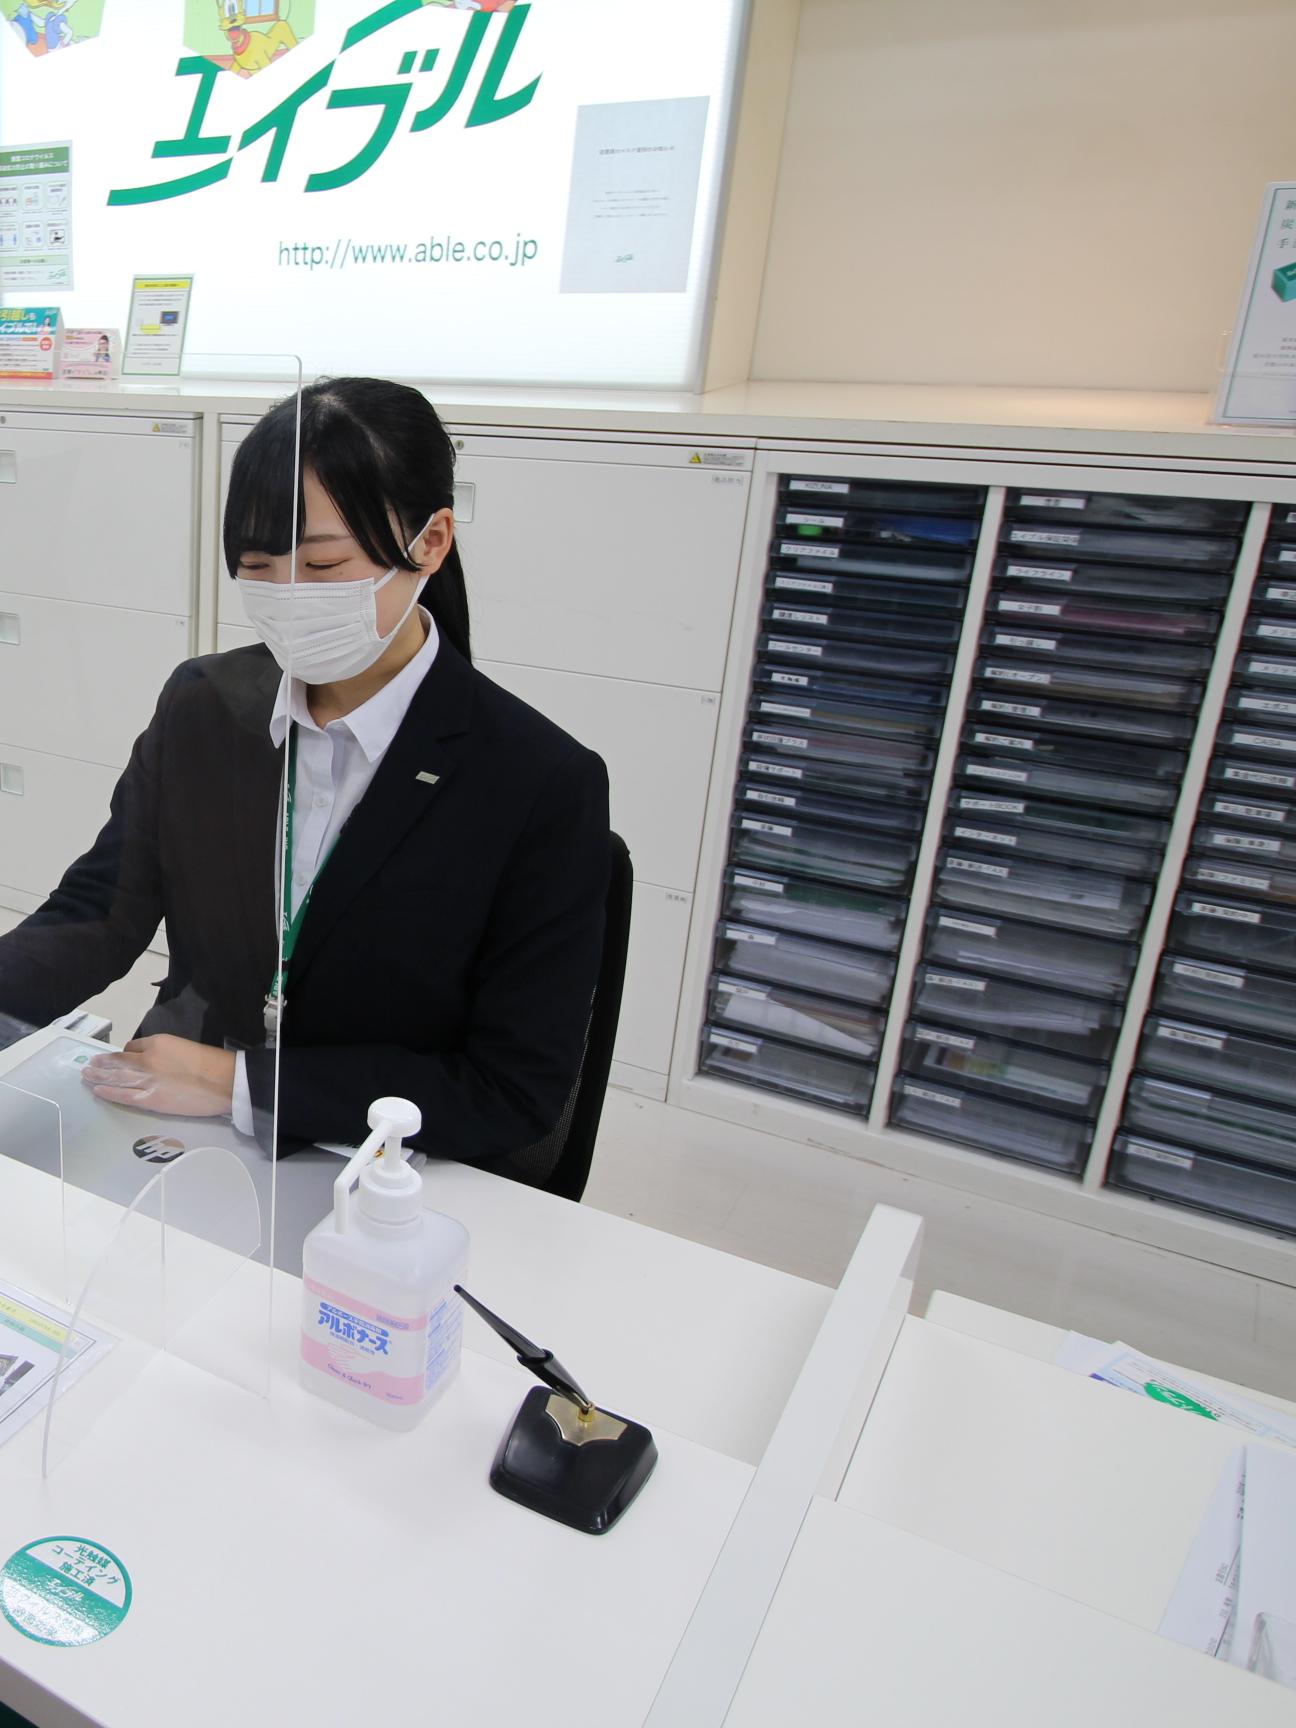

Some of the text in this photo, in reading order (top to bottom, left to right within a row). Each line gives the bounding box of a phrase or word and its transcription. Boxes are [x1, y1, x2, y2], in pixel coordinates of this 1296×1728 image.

[107, 0, 542, 205] エイブル
[278, 231, 538, 268] http://www.able.co.jp
[318, 1309, 390, 1356] アルボナース
[51, 1545, 121, 1585] コーティング
[58, 1562, 96, 1586] 施工済
[74, 1544, 111, 1569] 光触媒
